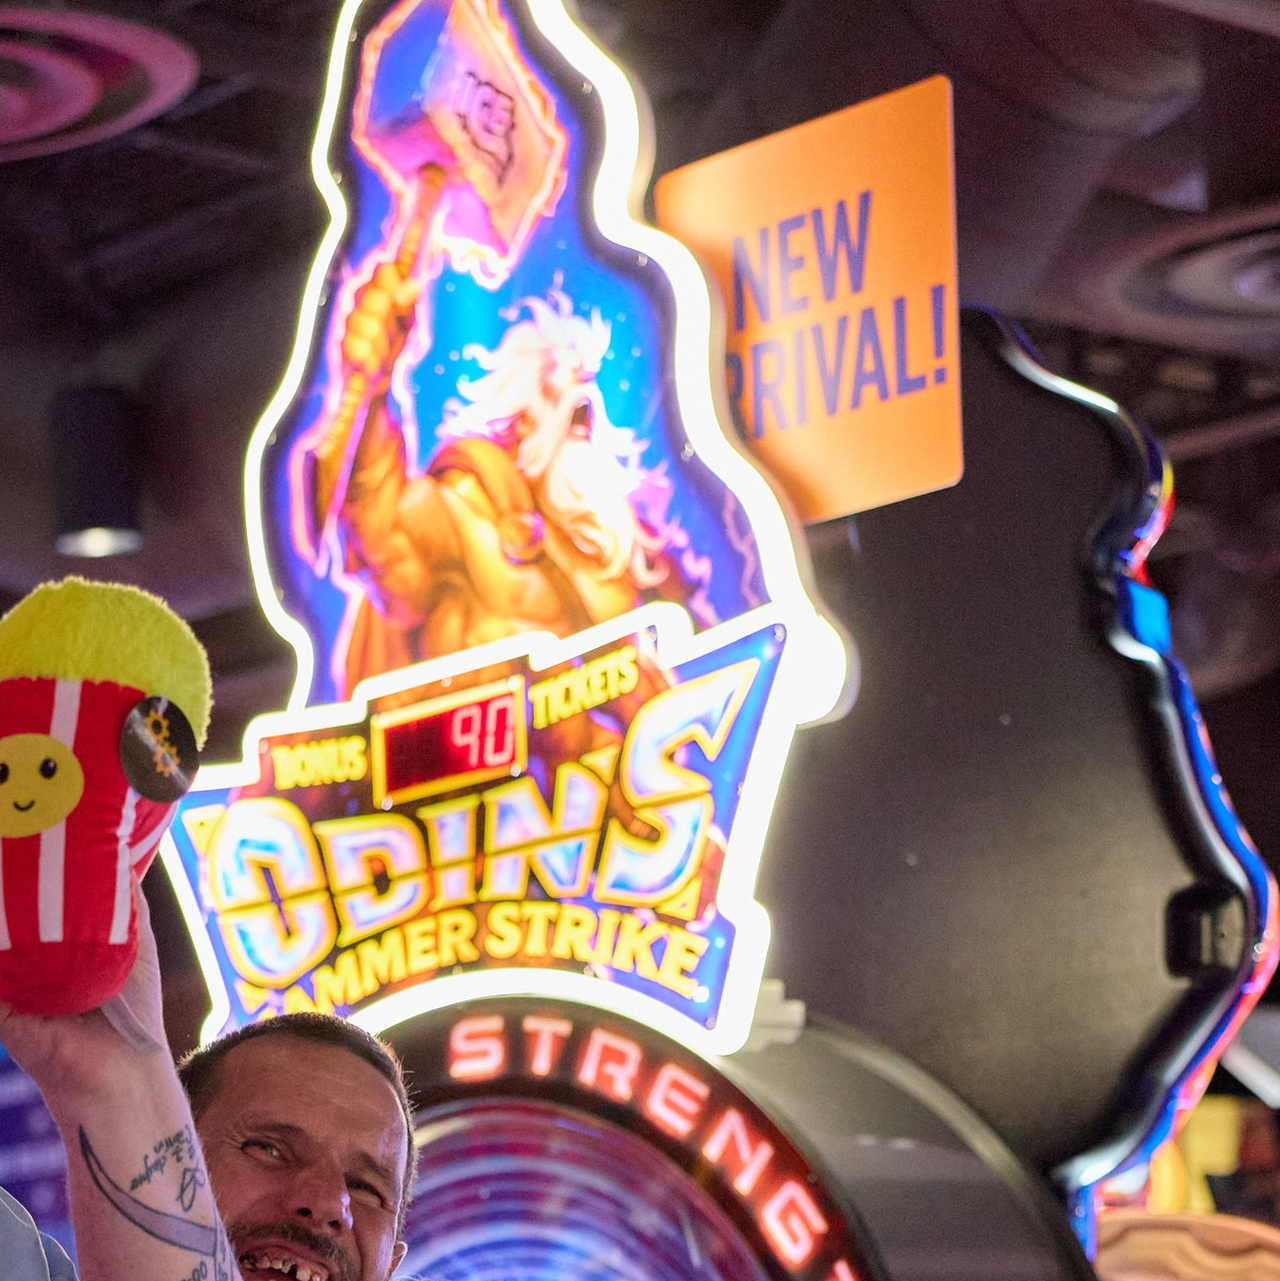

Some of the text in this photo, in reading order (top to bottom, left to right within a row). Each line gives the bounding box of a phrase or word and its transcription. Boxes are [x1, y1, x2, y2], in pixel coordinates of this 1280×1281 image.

[732, 188, 873, 332] NEW
[724, 283, 947, 446] RRIVAL!
[270, 644, 640, 790] BONUS 90 TICKETS
[258, 899, 710, 1018] AMMER STRIKE
